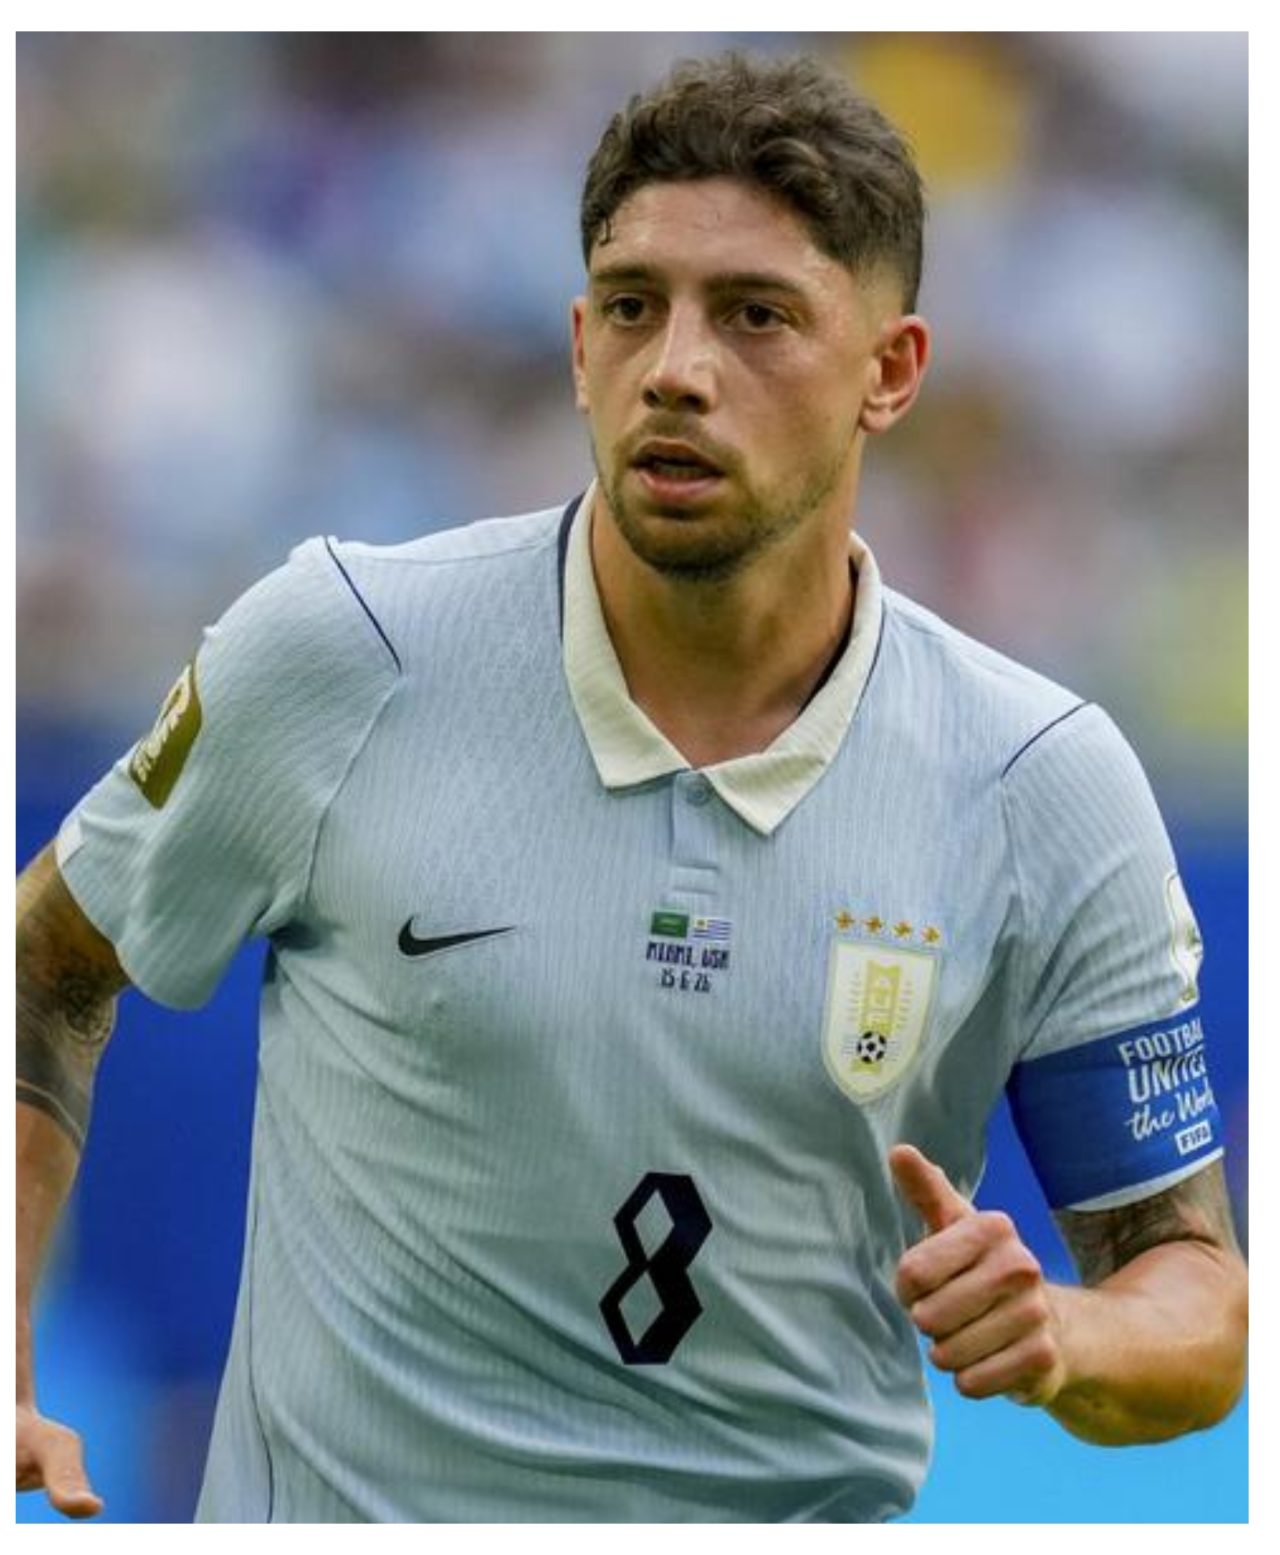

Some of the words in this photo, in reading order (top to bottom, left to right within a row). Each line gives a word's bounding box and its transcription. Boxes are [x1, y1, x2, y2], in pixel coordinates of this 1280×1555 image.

[1125, 1103, 1176, 1141] the
[1178, 1122, 1210, 1151] FIFA
[599, 1172, 713, 1364] 8
